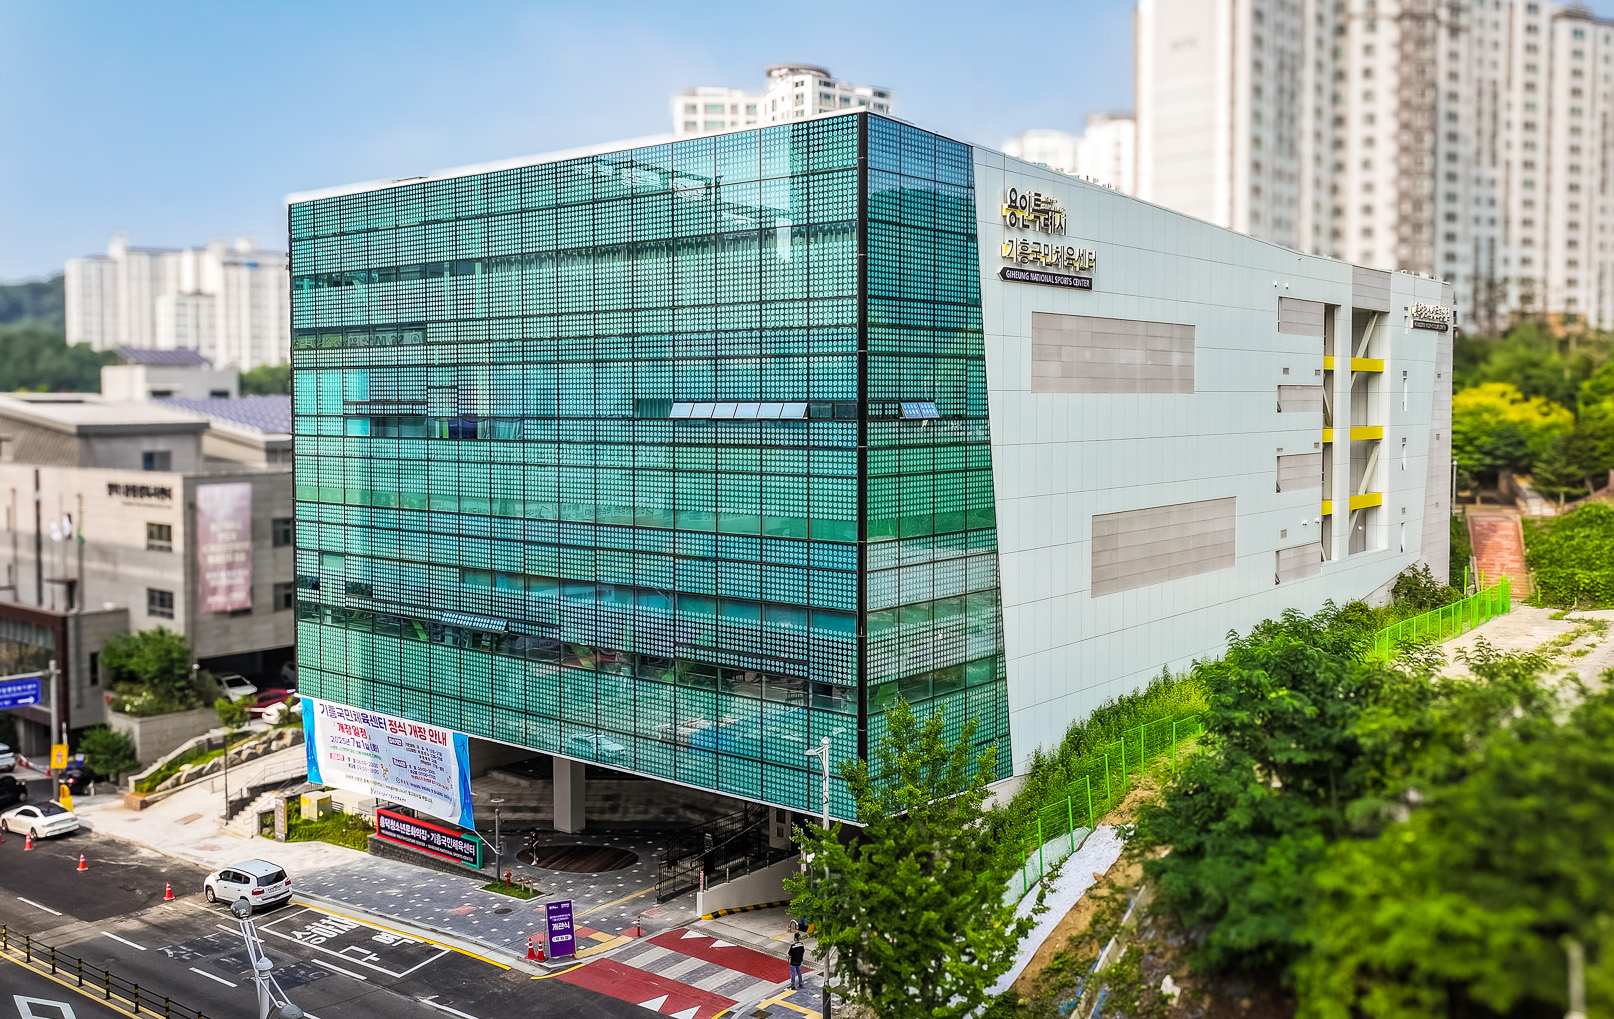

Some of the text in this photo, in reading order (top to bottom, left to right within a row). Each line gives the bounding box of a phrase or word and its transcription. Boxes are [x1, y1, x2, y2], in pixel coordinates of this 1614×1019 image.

[1006, 237, 1097, 274] 기흥국민체육센터
[1006, 269, 1090, 288] GIHEUNG NATIONAL SPORTS CENTER
[319, 703, 387, 732] 기흥국민체육센터
[388, 719, 407, 736] 정식
[408, 723, 427, 741] 개장
[428, 727, 447, 746] 안내
[290, 915, 361, 944] 승하차
